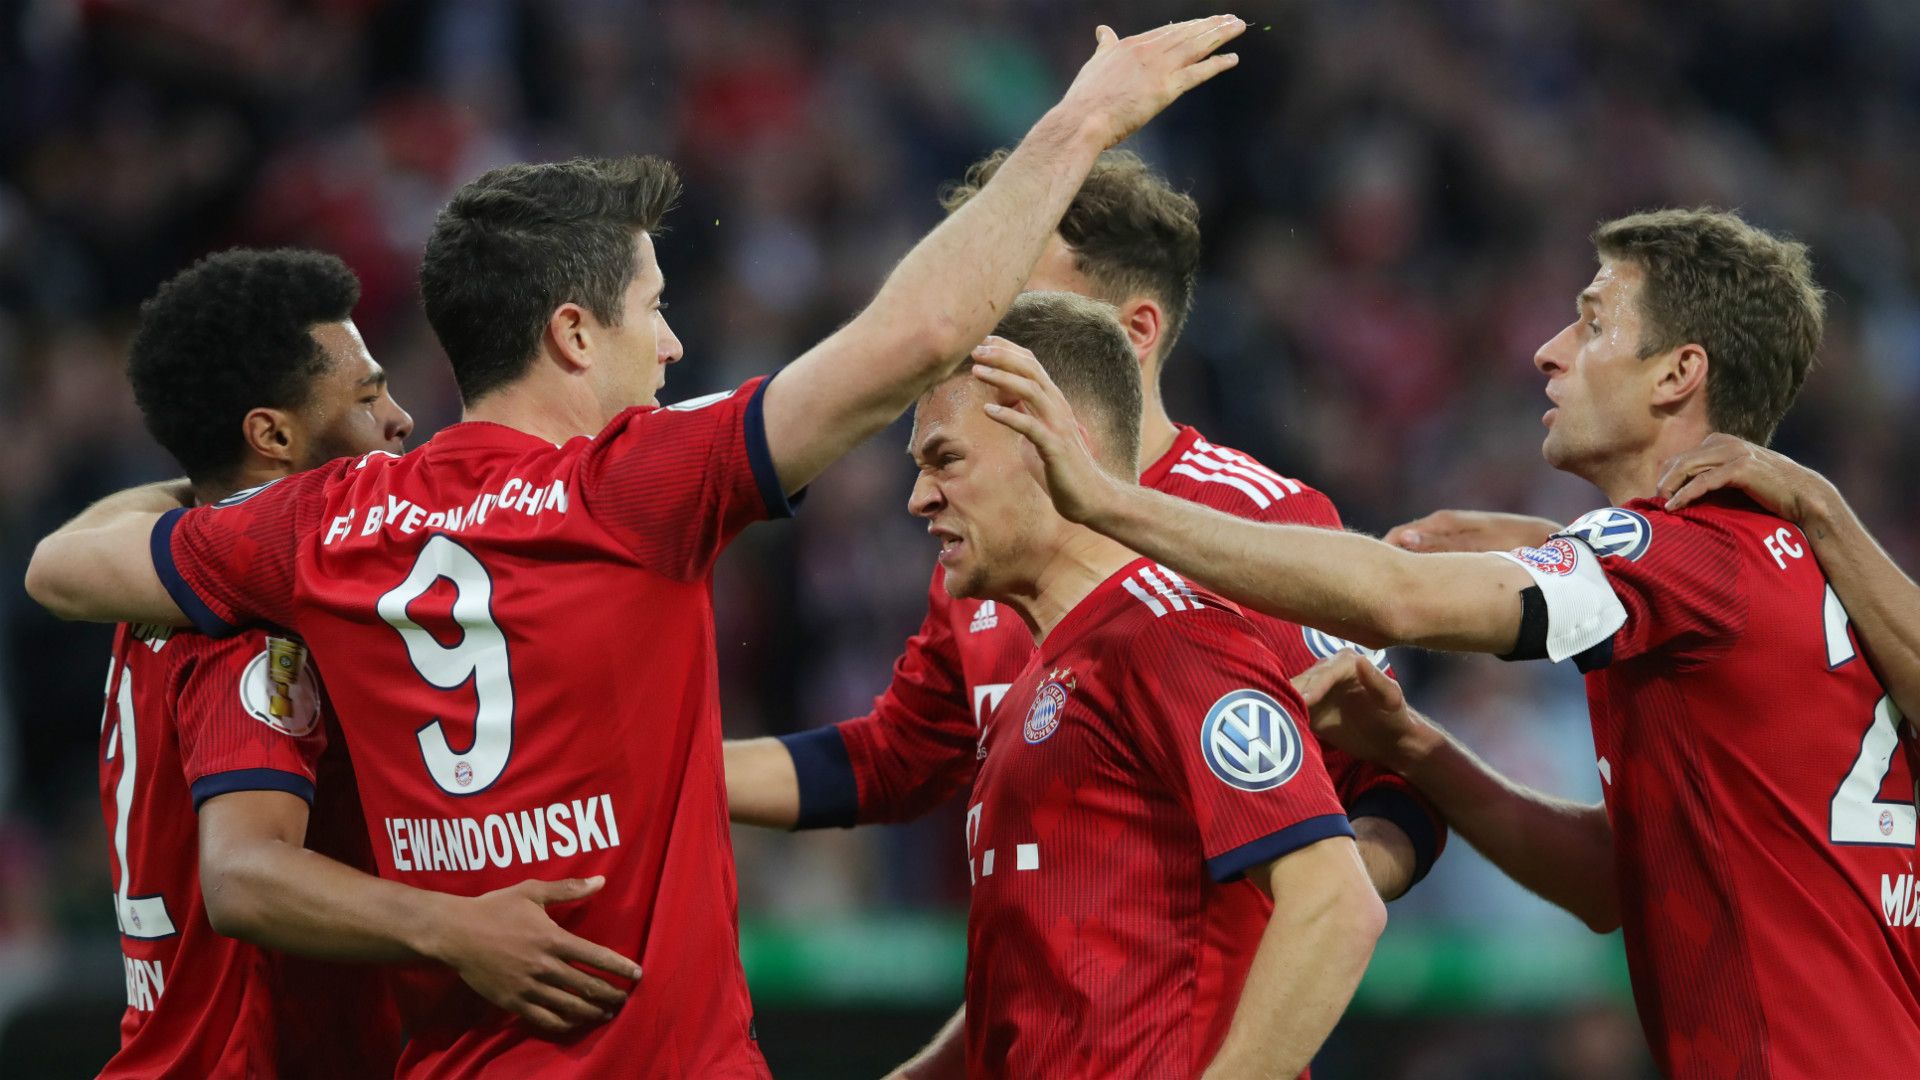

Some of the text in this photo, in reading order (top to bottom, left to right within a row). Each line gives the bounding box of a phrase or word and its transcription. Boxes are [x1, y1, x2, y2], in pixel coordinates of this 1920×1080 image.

[361, 494, 465, 535] BYERN
[1763, 527, 1803, 570] FC
[377, 533, 514, 793] 9
[1211, 699, 1294, 781] VW
